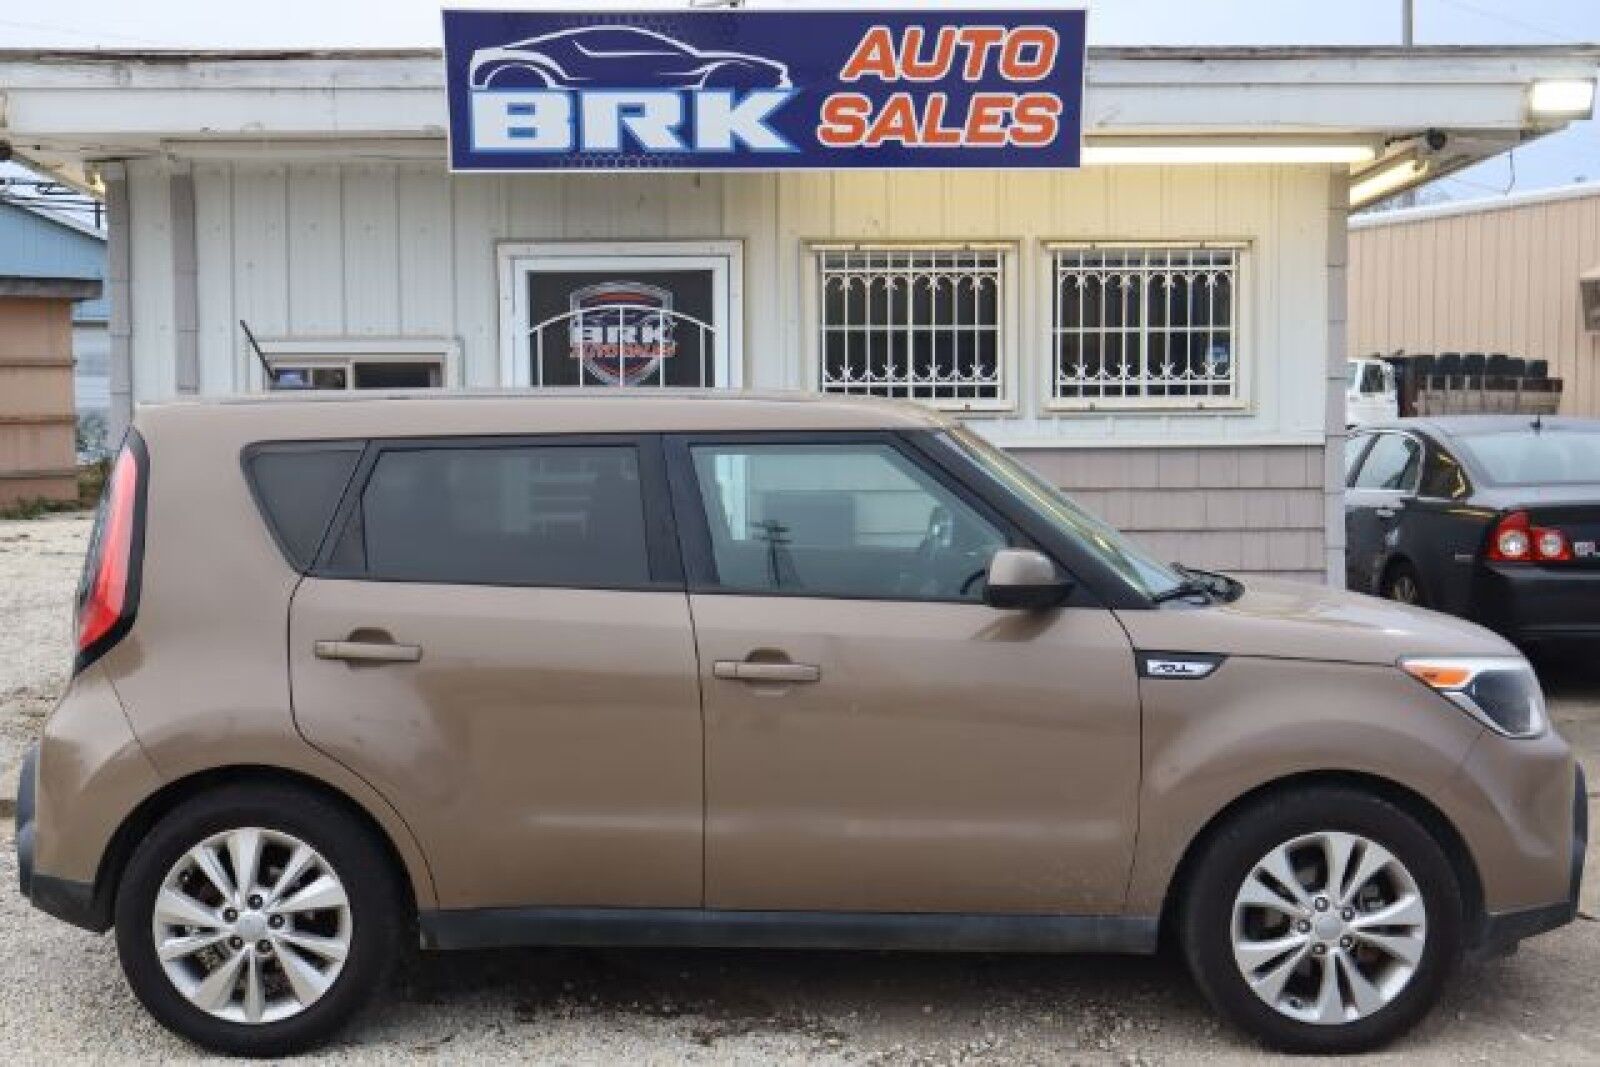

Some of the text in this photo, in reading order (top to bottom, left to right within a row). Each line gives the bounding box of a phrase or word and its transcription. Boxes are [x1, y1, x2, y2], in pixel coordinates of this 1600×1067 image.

[840, 24, 1060, 81] AUTO
[471, 89, 798, 151] BRK
[817, 91, 1063, 147] SALES
